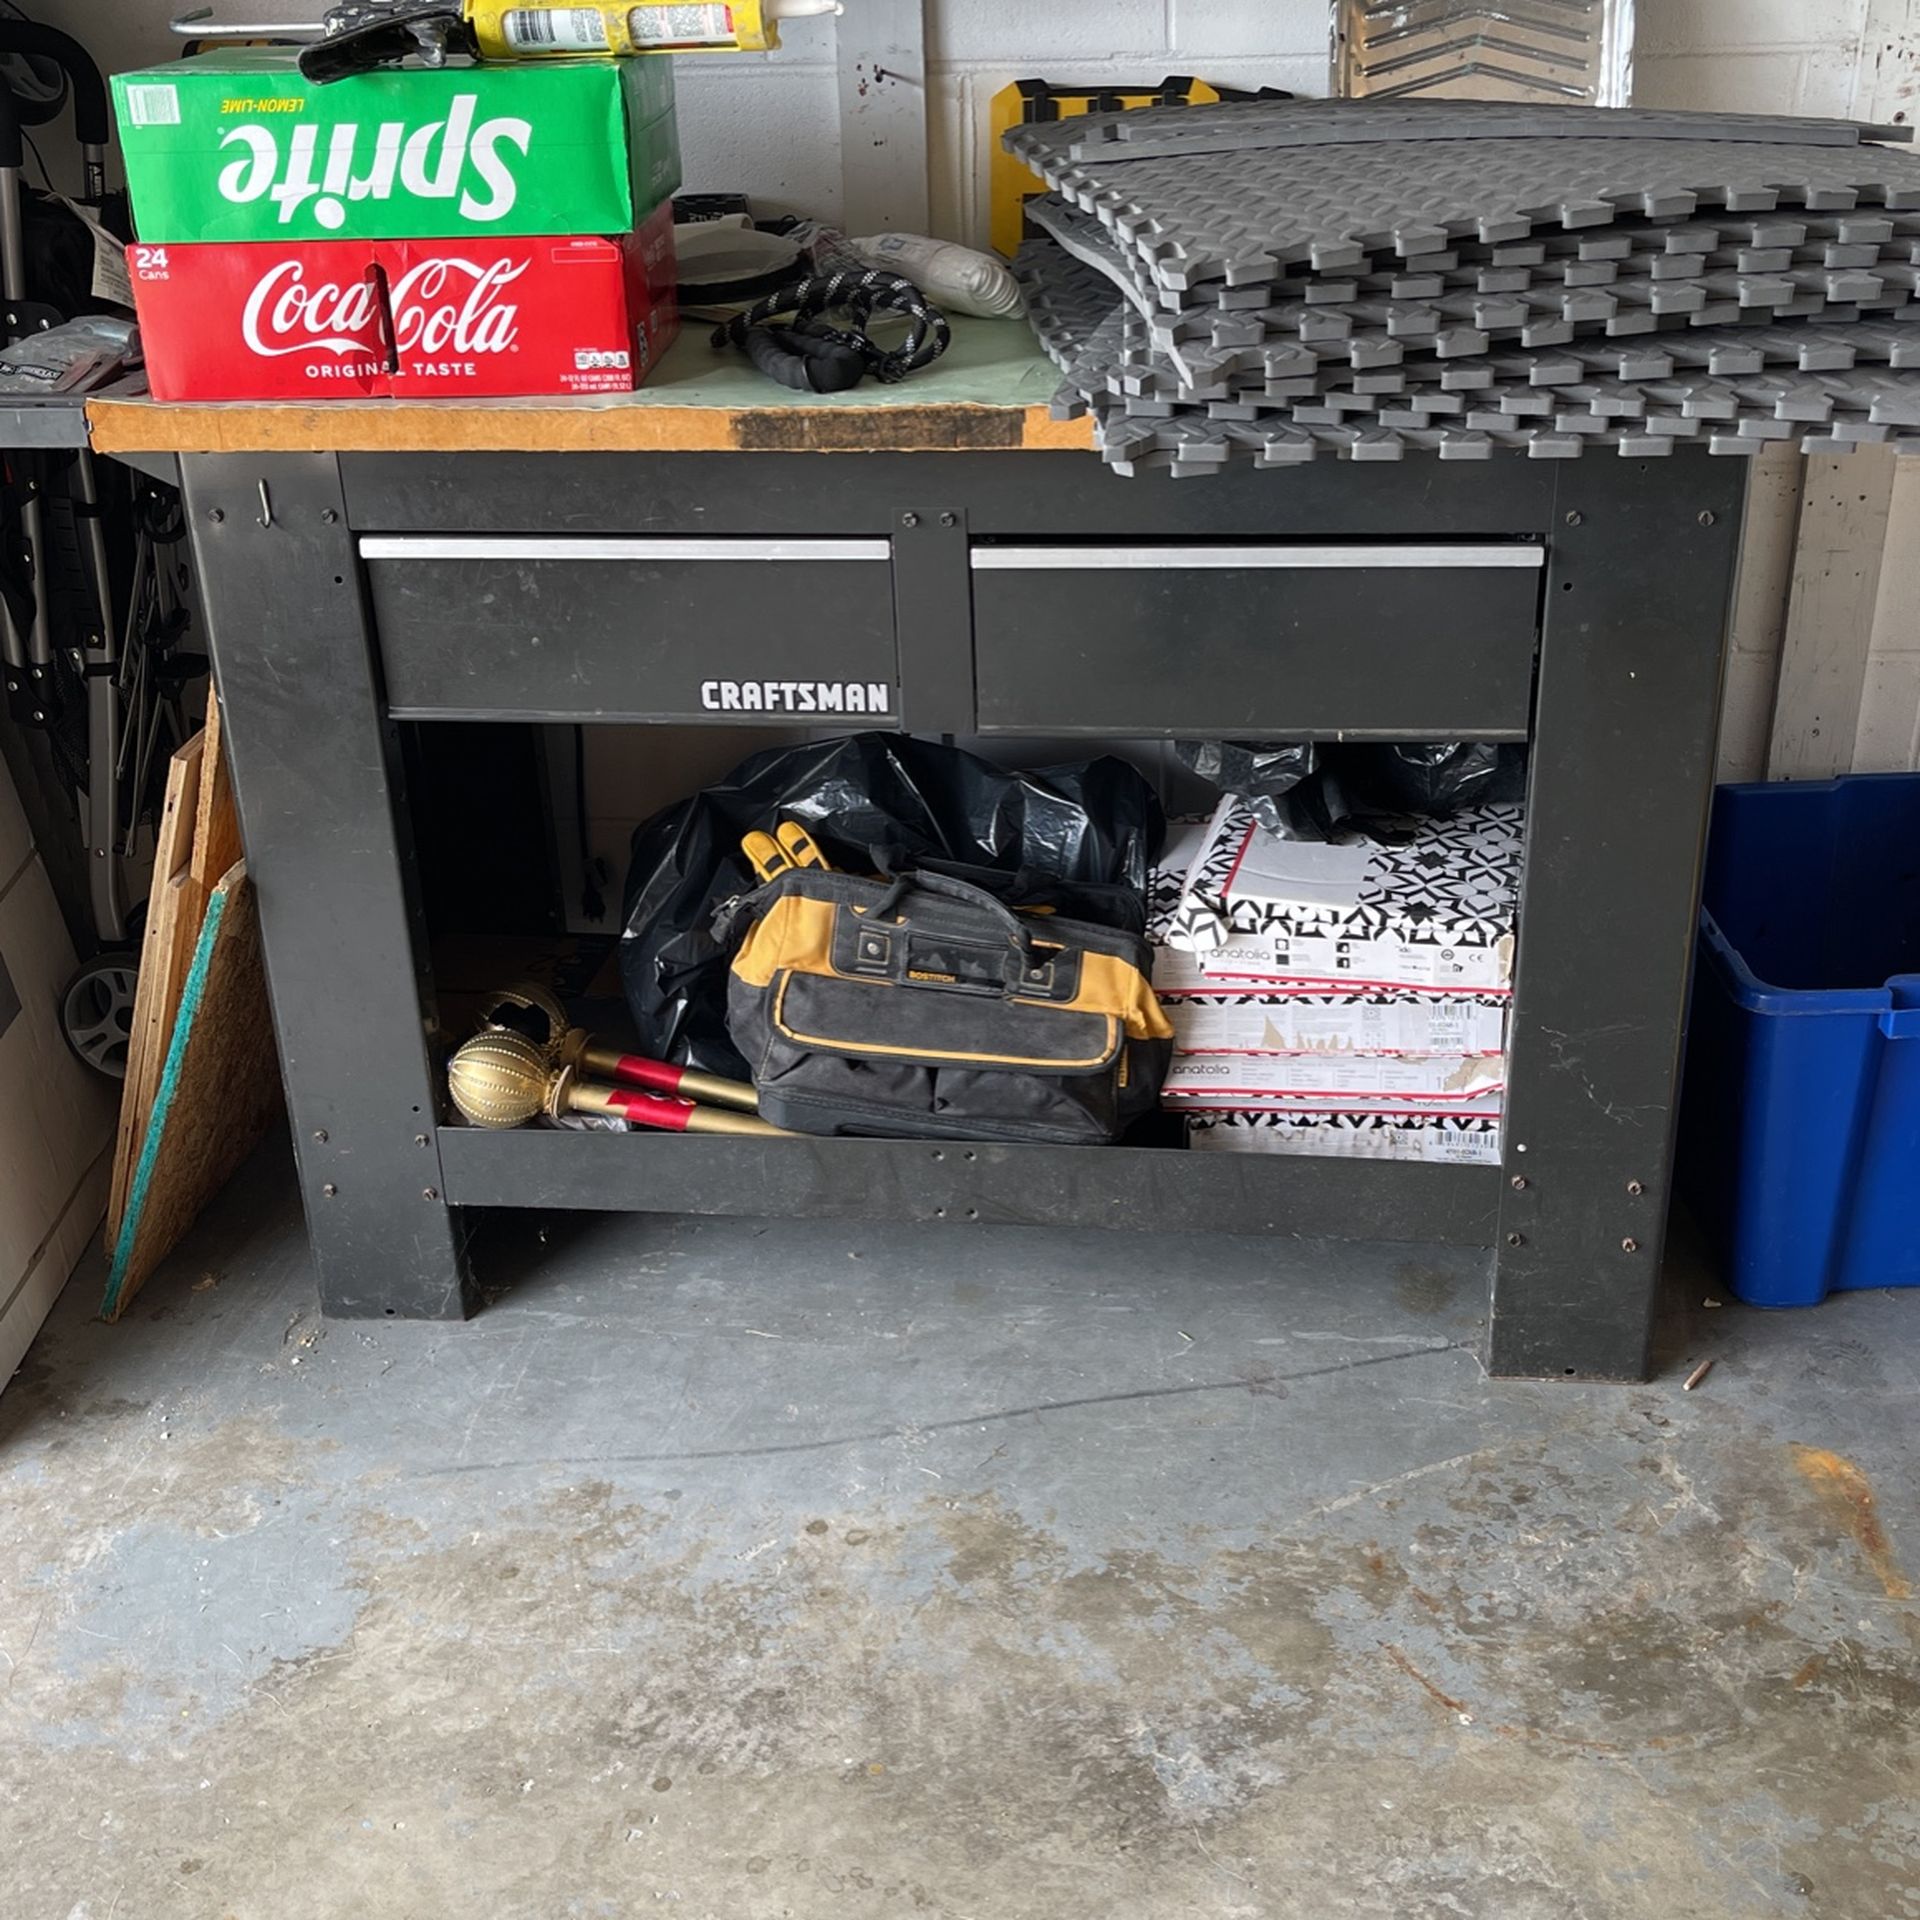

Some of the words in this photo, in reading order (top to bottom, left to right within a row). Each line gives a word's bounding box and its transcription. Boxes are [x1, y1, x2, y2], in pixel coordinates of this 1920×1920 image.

[220, 97, 305, 114] LEMON-LIME
[217, 93, 533, 230] Sprite
[135, 247, 169, 269] 24
[138, 269, 170, 281] Cans
[242, 260, 378, 357] Coca
[379, 257, 531, 355] Cola
[413, 362, 477, 376] TASTE
[701, 680, 889, 713] CRAFTSMAN
[1210, 947, 1271, 961] anatolia
[1172, 1063, 1231, 1076] anatolia
